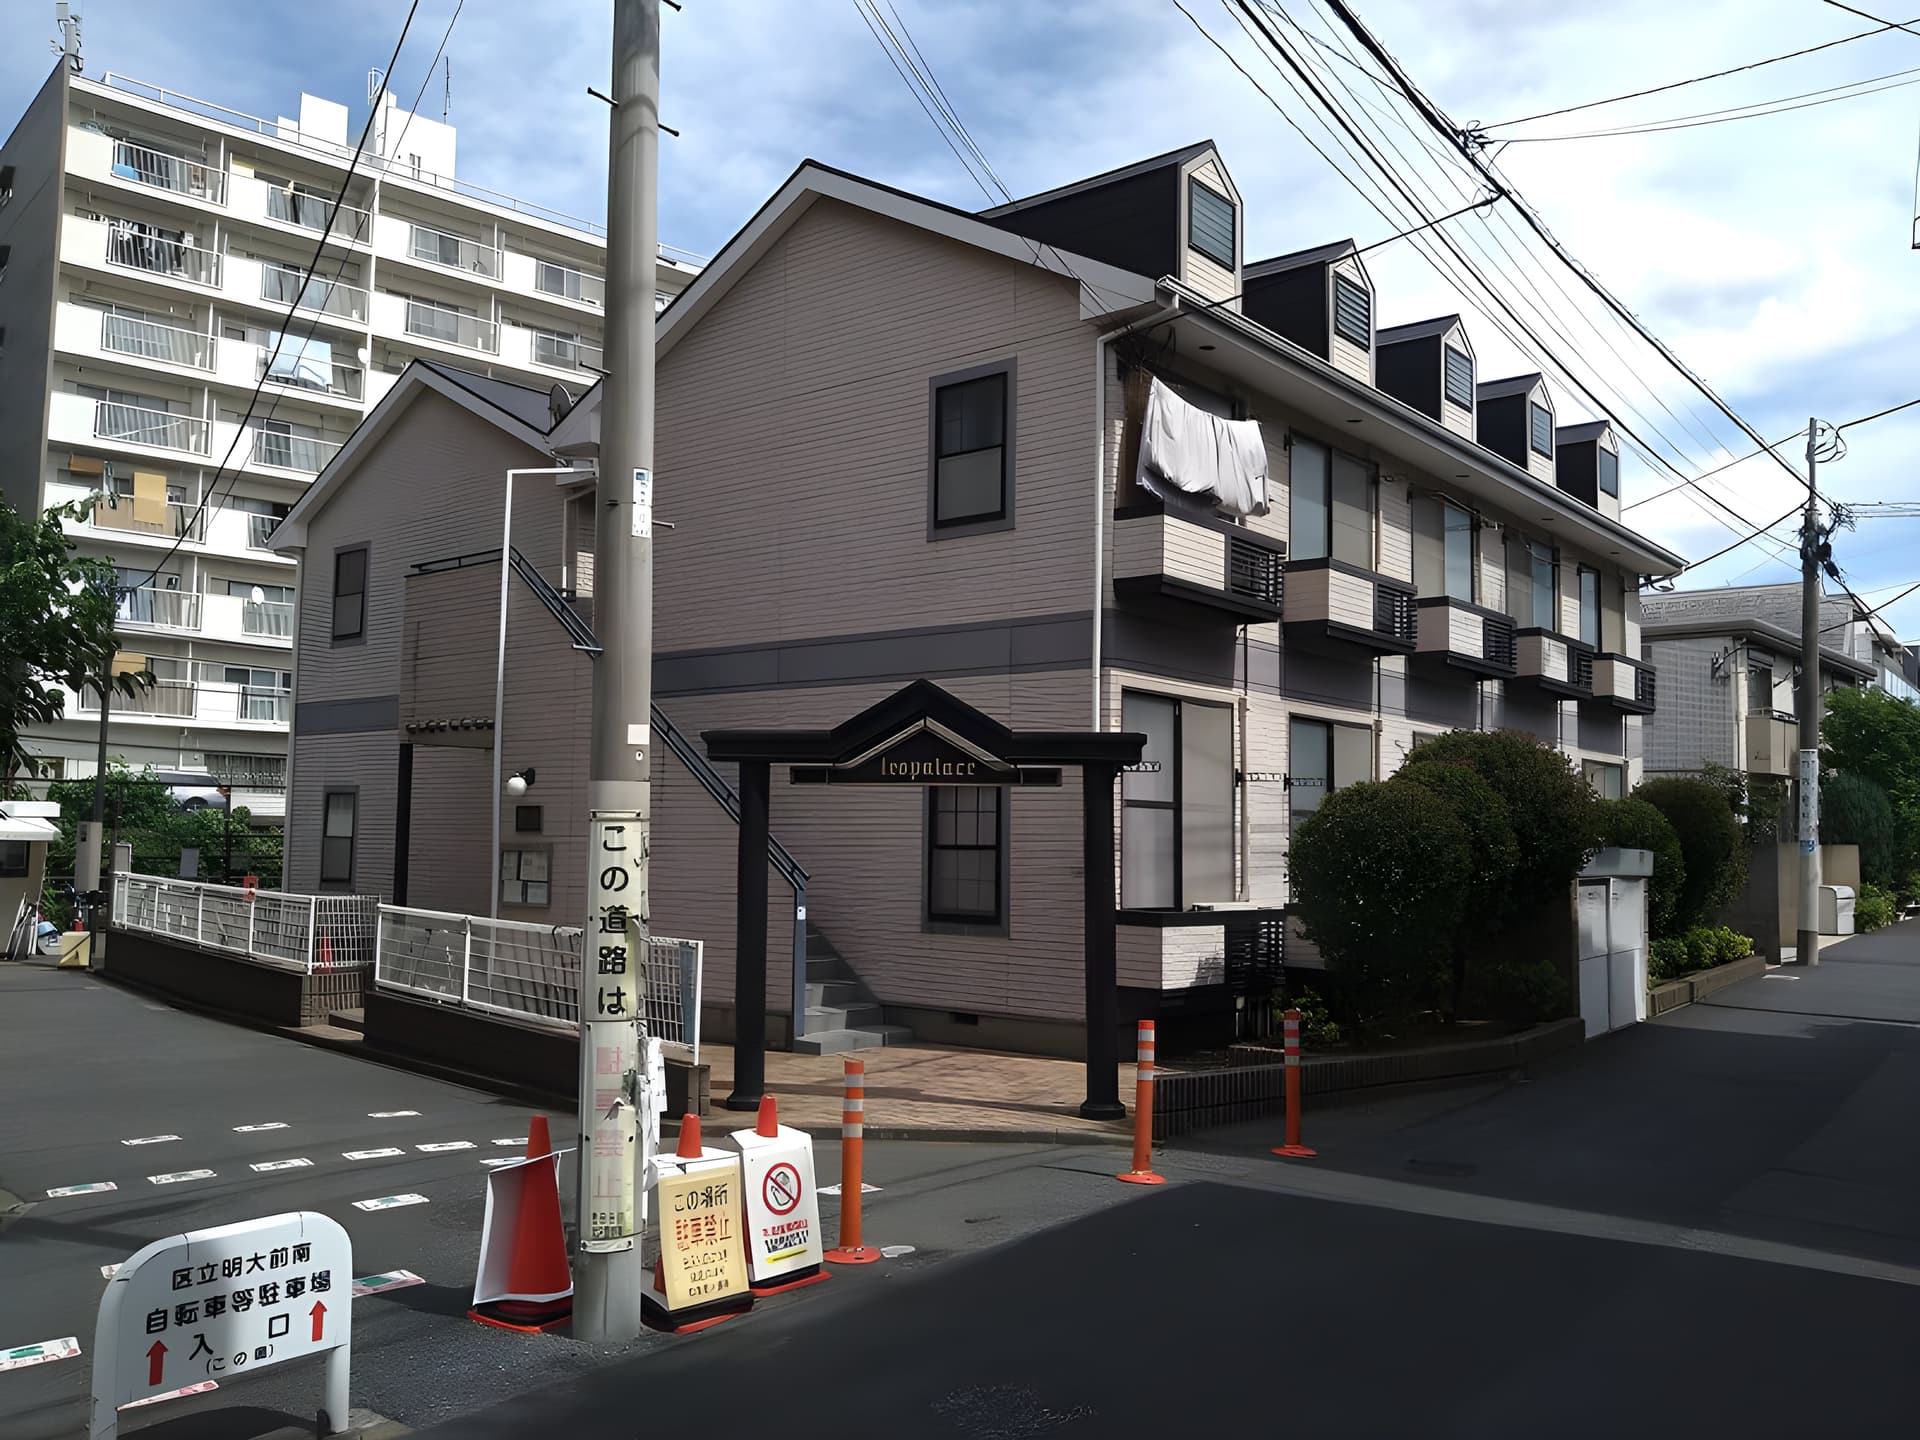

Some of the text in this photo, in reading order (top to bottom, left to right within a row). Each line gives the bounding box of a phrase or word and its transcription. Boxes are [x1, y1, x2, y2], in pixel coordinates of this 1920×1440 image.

[599, 825, 629, 1015] この道路は
[171, 1242, 311, 1290] 区立明大前南
